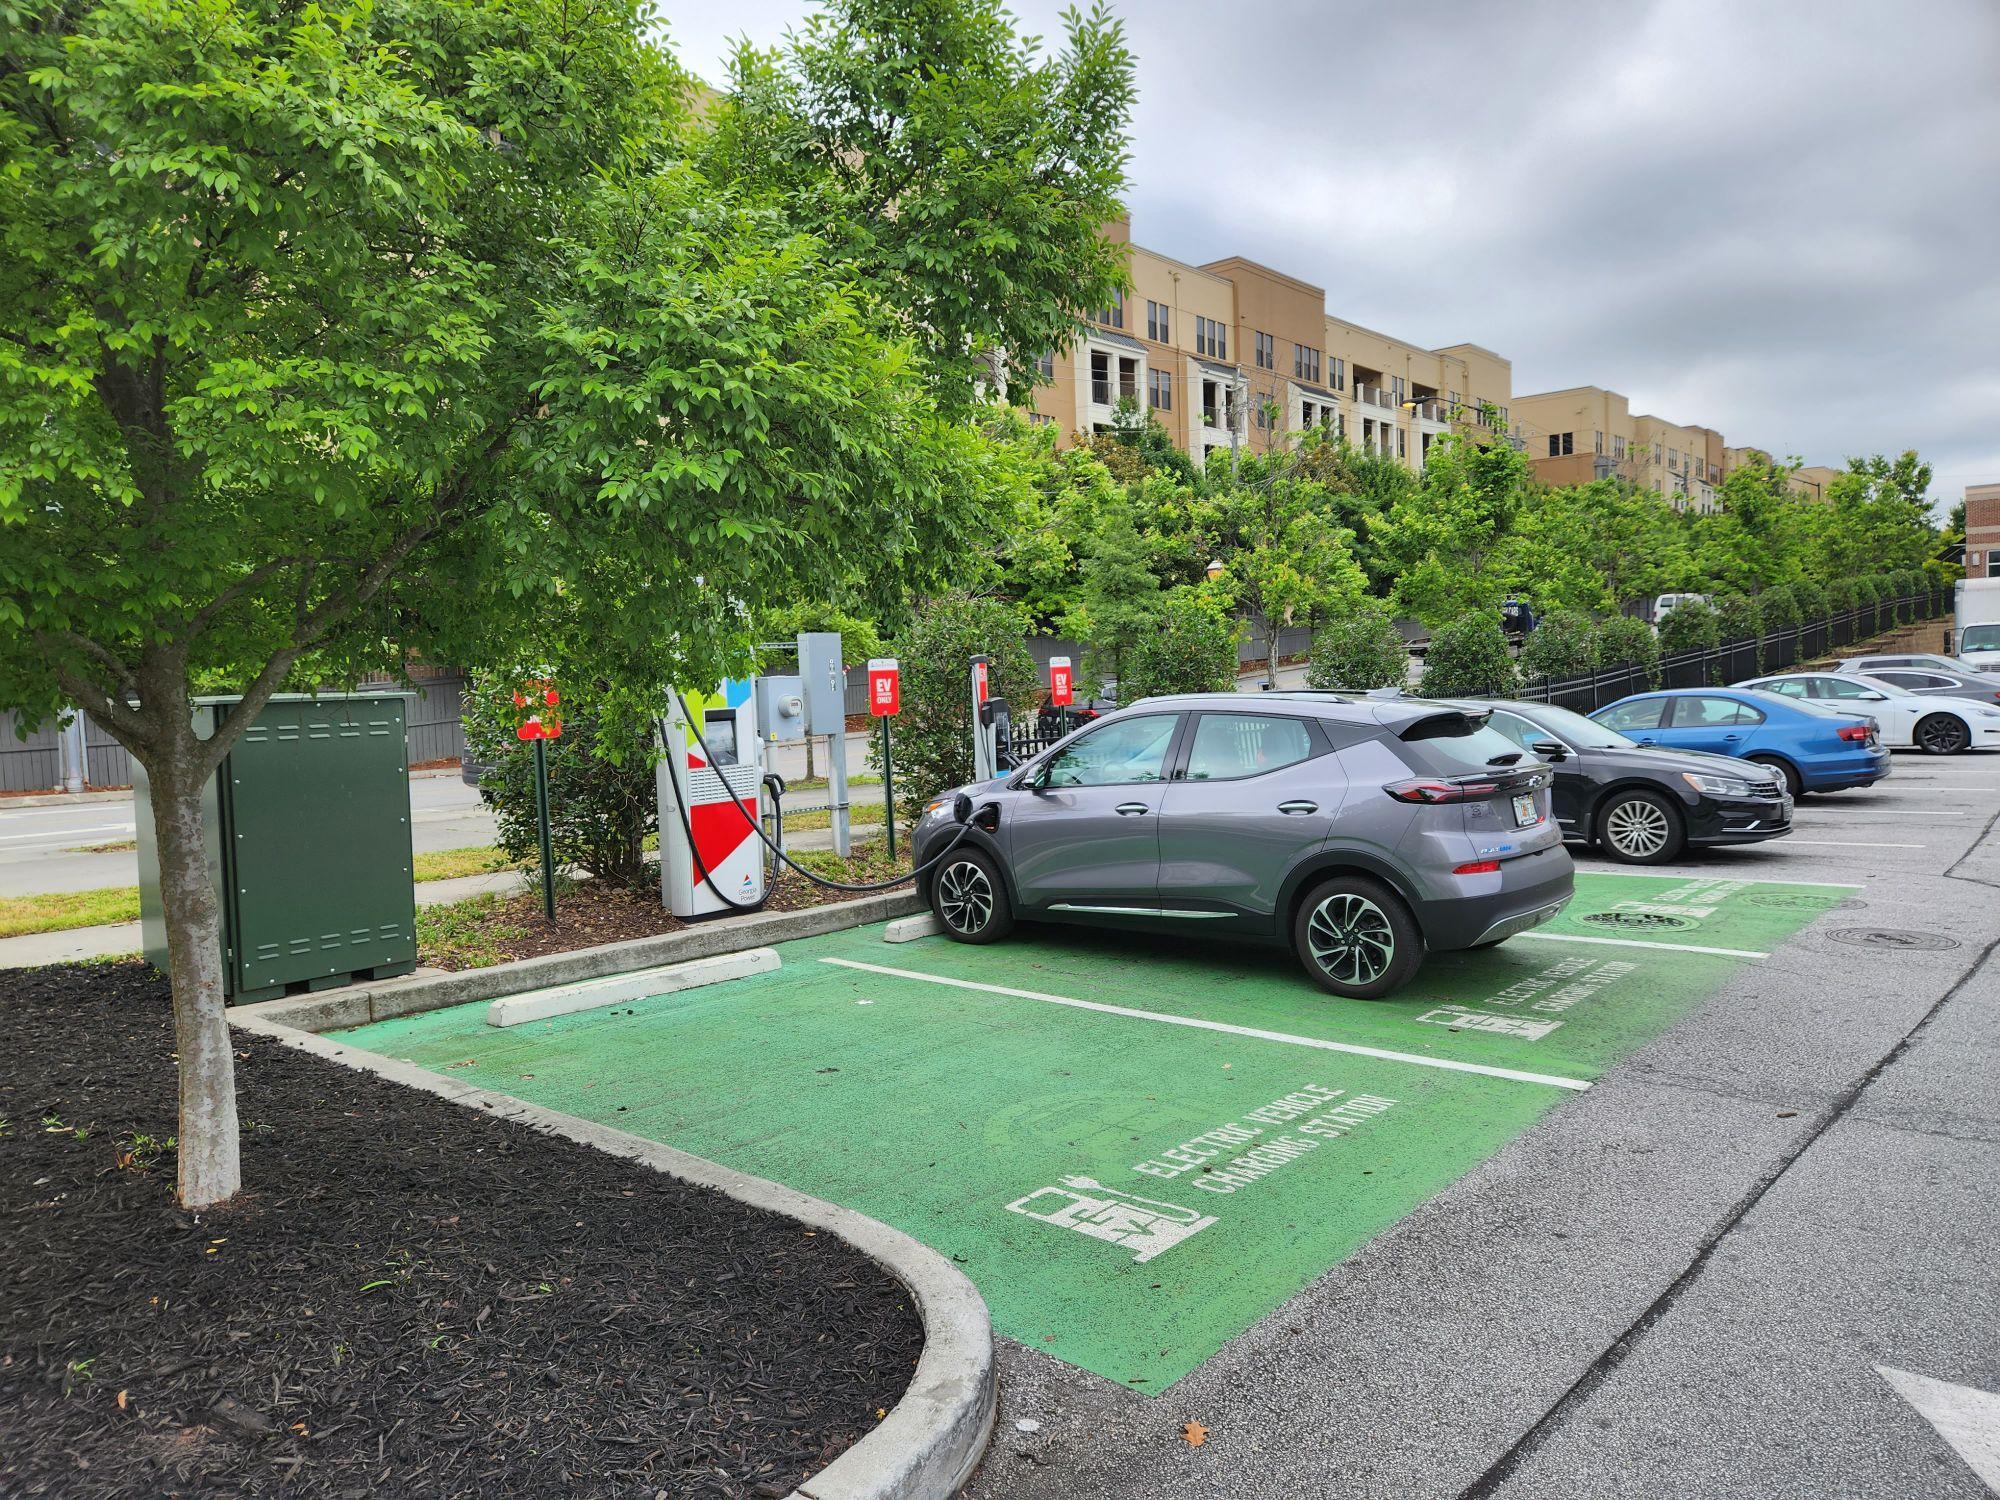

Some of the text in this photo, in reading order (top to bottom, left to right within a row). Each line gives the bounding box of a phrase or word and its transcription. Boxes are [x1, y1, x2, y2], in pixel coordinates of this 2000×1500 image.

[876, 678, 892, 693] EV
[1055, 673, 1067, 686] EV
[876, 696, 893, 704] ONLY
[1133, 1083, 1346, 1179] ELECTRIC VEHICLE
[1192, 1093, 1401, 1194] CHARGING STATION
